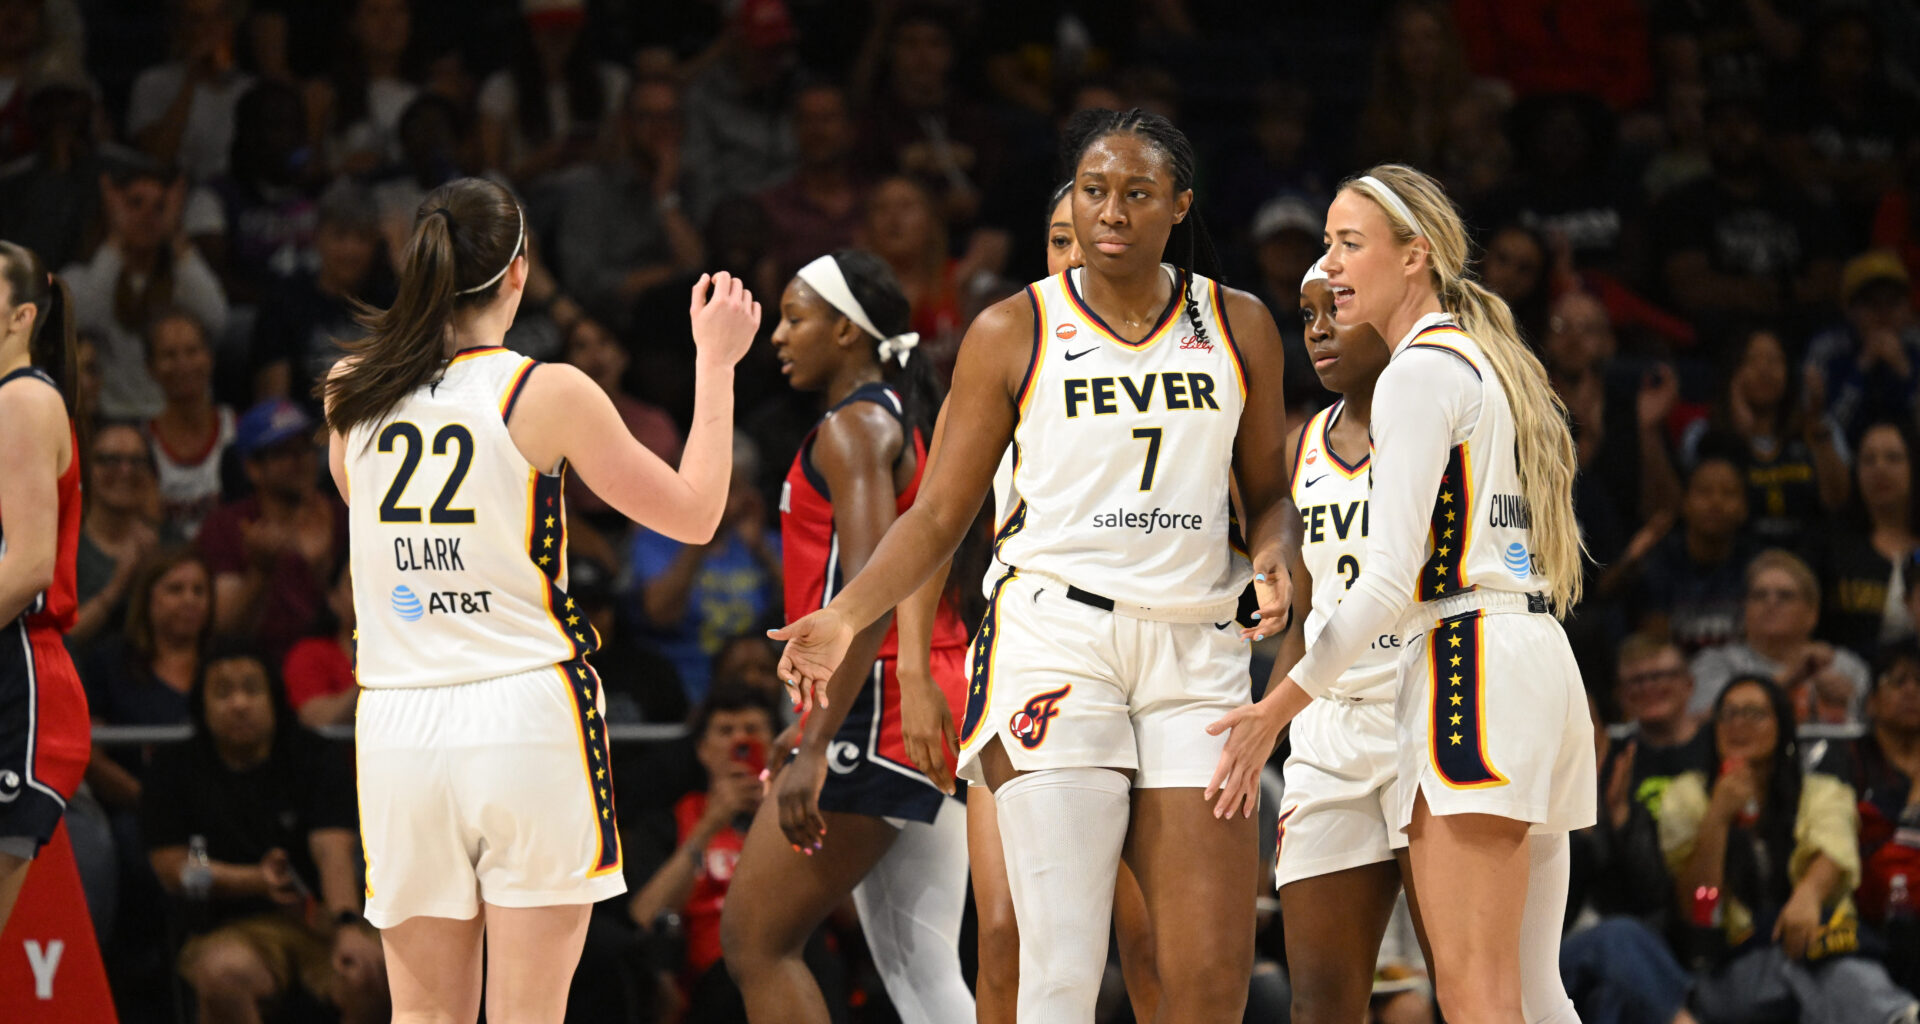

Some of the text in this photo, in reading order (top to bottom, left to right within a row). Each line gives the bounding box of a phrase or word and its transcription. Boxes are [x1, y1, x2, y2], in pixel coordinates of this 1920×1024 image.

[1064, 372, 1221, 419] FEVER
[378, 421, 476, 525] 22
[1132, 426, 1163, 493] 7
[1093, 507, 1202, 533] salesforce
[394, 537, 465, 572] CLARK
[429, 591, 492, 615] AT&T
[23, 939, 65, 1001] Y
